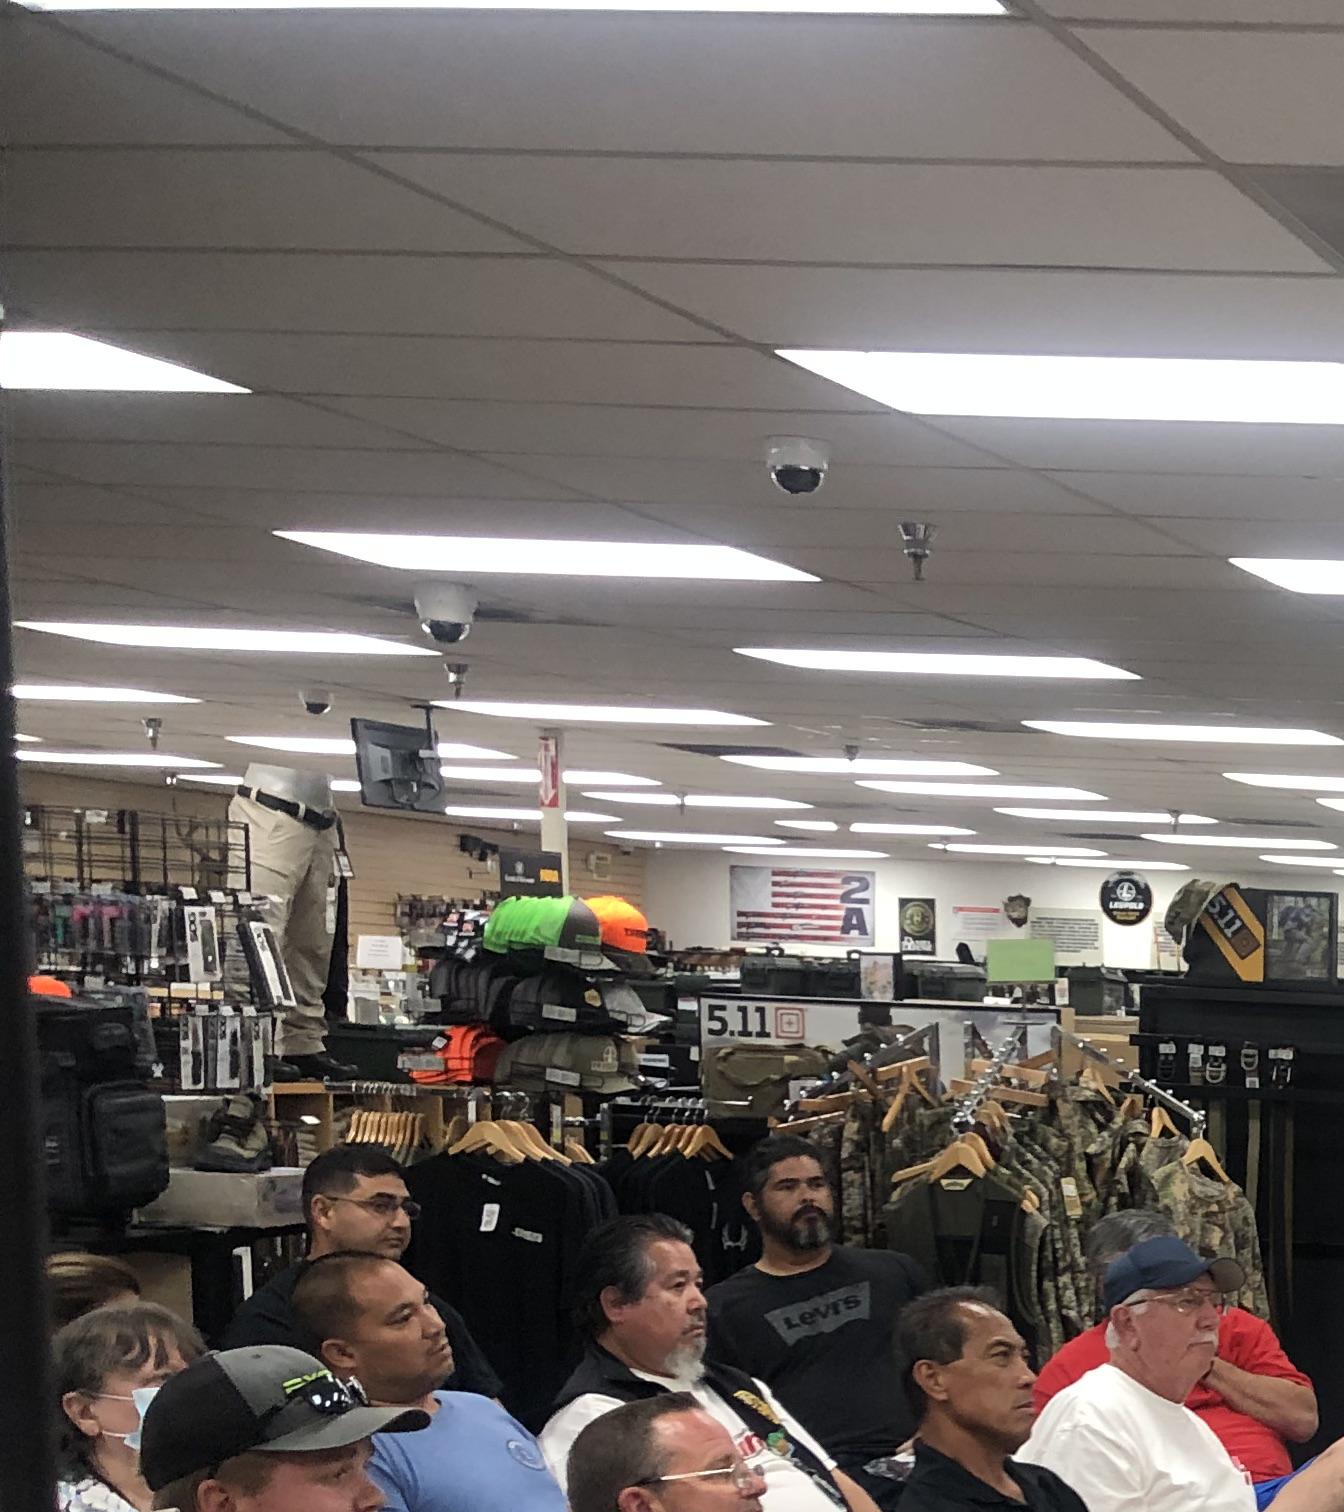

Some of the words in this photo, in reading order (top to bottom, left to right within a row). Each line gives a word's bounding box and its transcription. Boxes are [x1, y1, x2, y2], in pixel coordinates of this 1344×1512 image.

[840, 876, 870, 904] 2
[840, 907, 869, 935] A
[707, 1004, 771, 1038] 5.11
